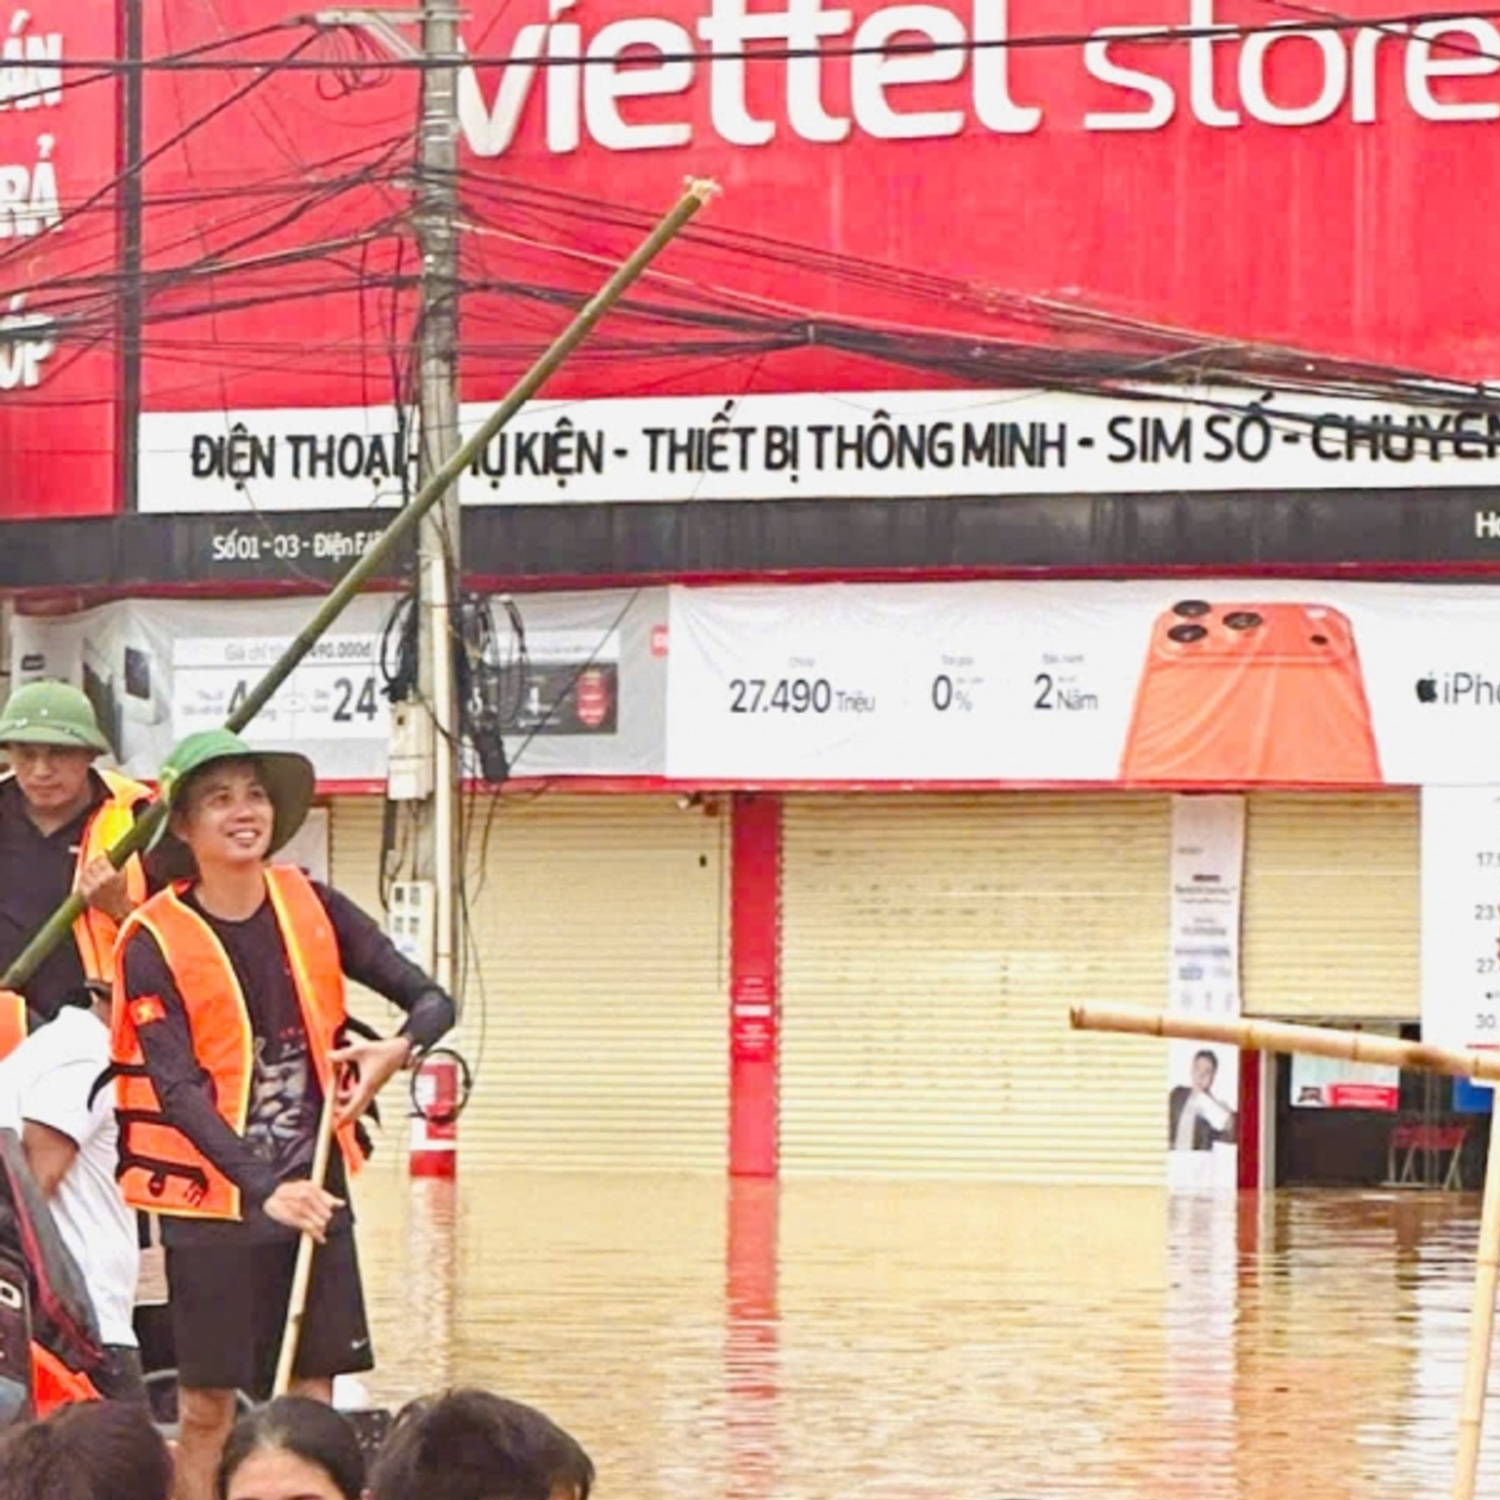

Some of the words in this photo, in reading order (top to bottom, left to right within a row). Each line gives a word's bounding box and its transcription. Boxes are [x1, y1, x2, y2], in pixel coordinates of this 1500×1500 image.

[190, 422, 276, 491] ĐIỆN
[515, 416, 604, 488] KIỆN
[642, 400, 757, 474] THIẾT
[764, 425, 799, 483] BỊ
[807, 408, 954, 470] THÔNG
[961, 422, 1067, 468] MINH
[1107, 416, 1191, 463] SIM
[332, 677, 378, 721] 24
[729, 679, 832, 713] 27.490
[931, 674, 953, 711] 0
[1033, 671, 1053, 709] 2
